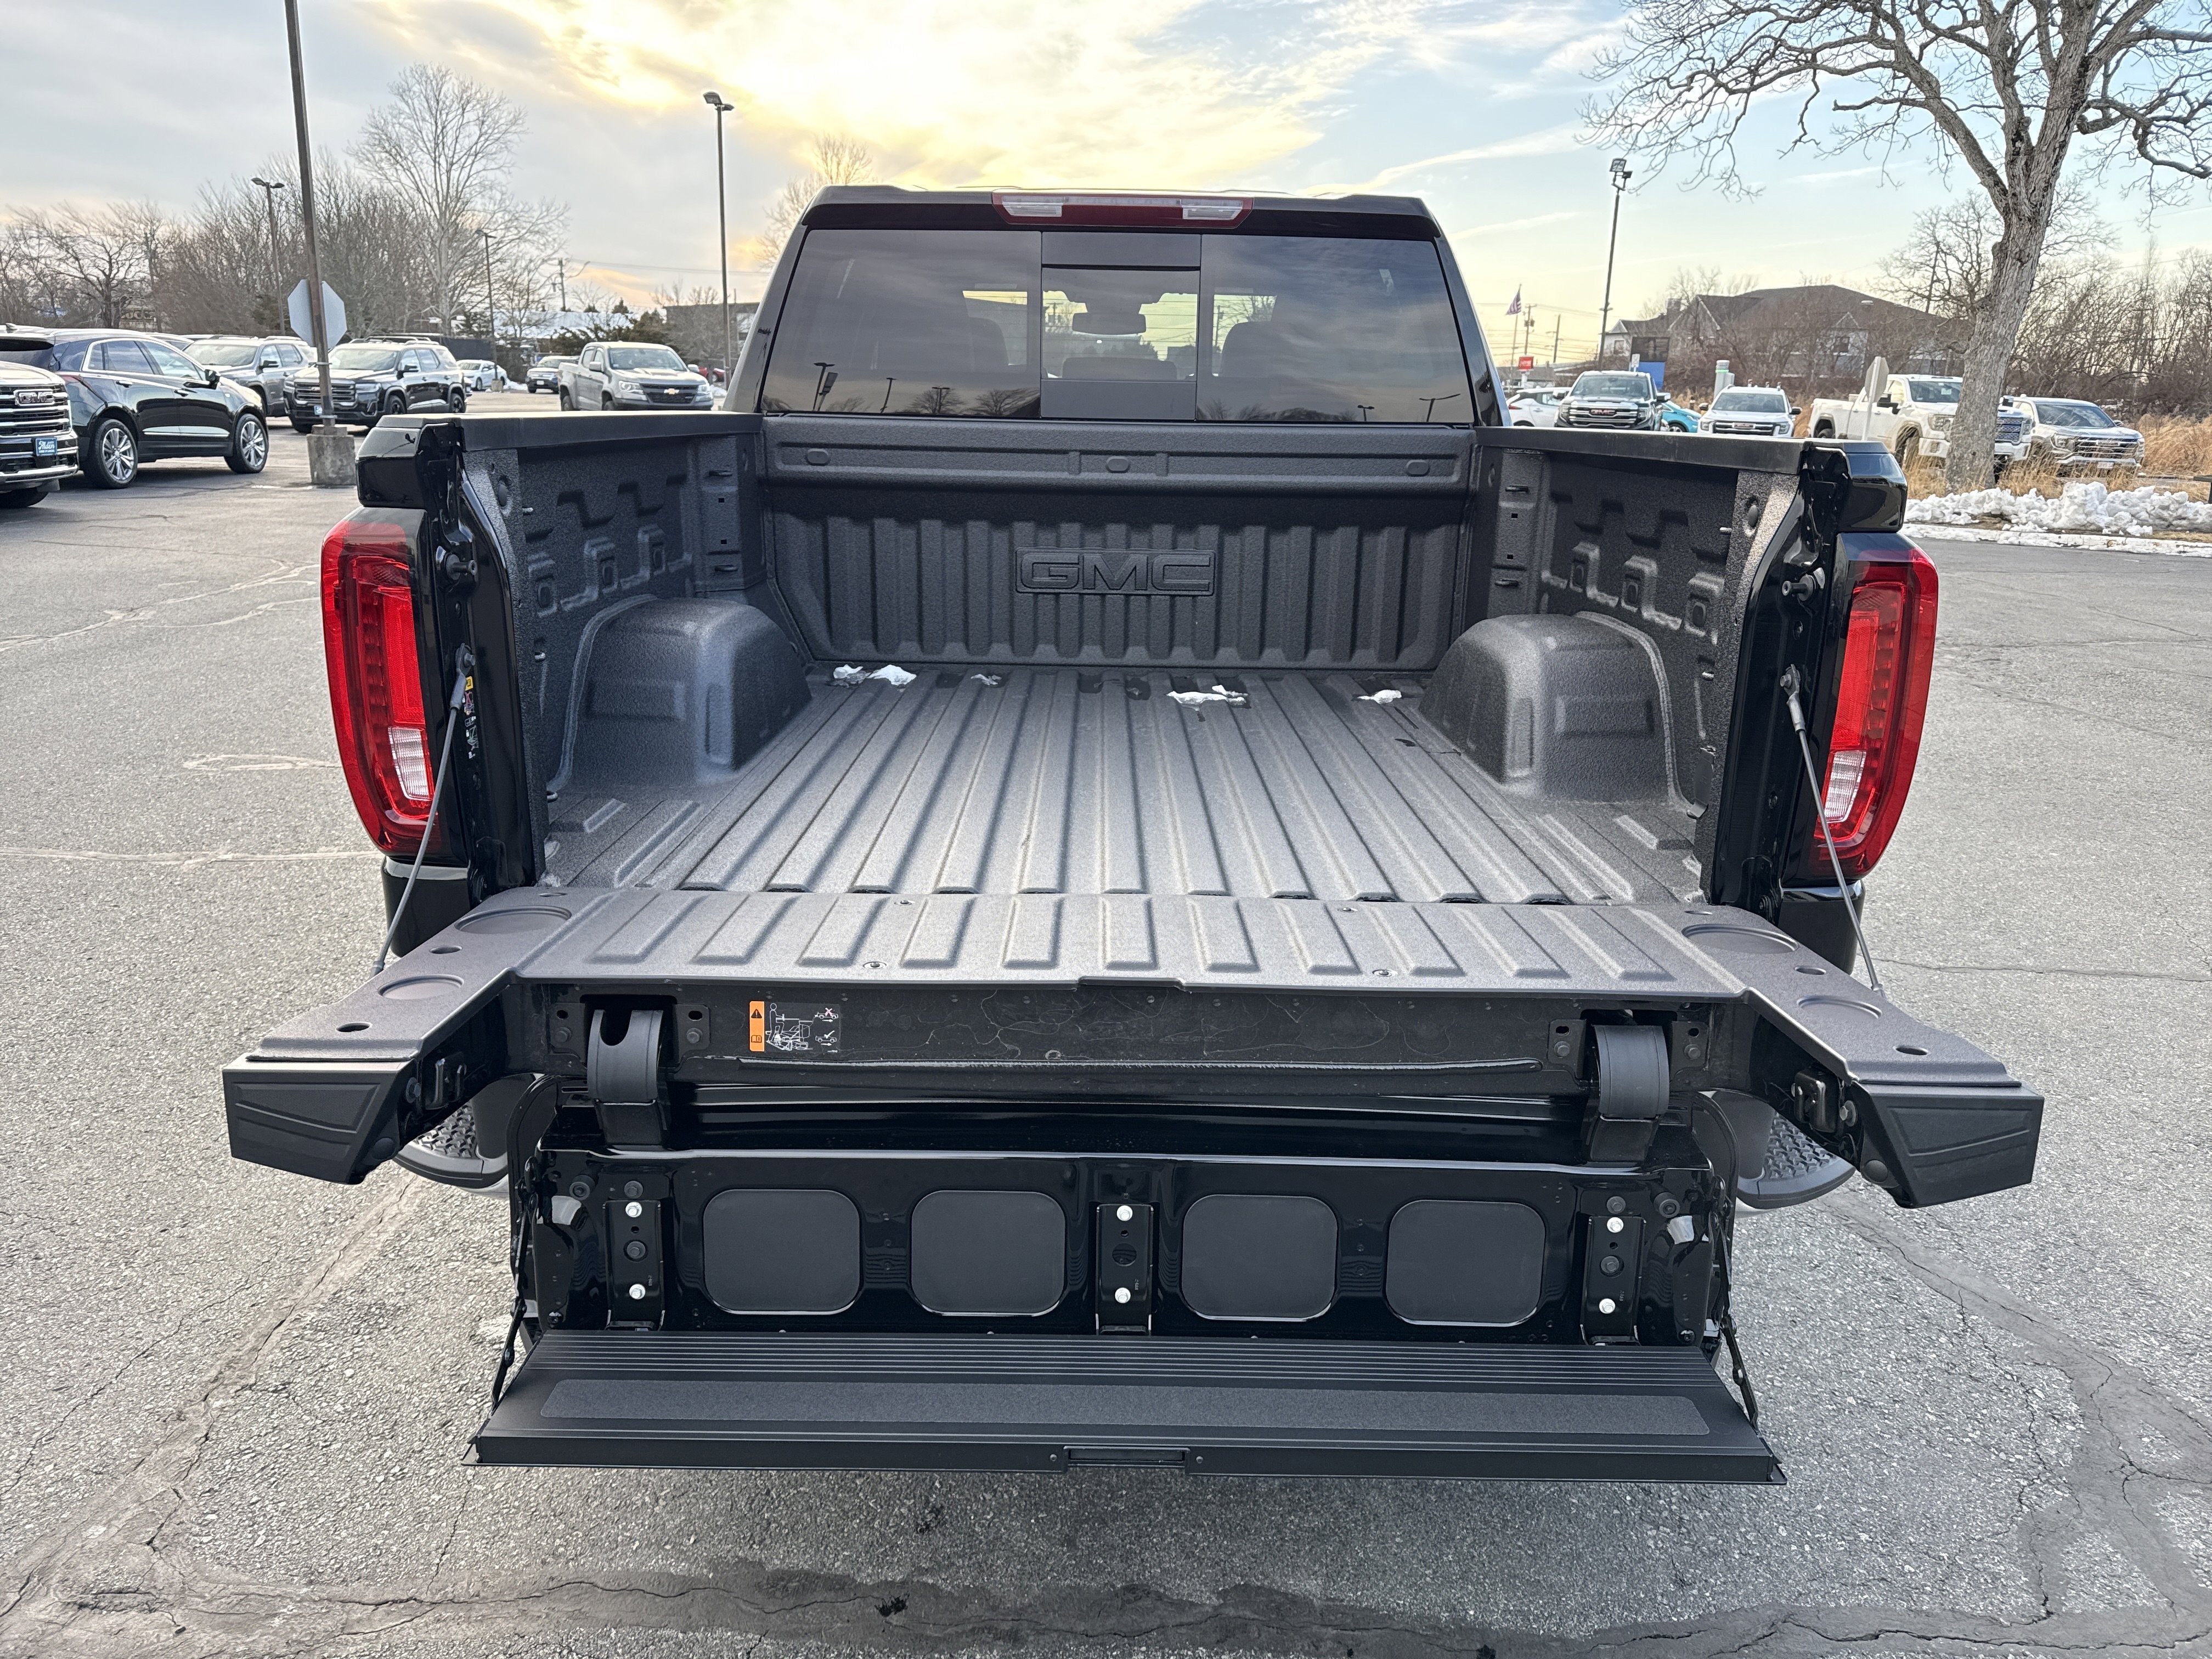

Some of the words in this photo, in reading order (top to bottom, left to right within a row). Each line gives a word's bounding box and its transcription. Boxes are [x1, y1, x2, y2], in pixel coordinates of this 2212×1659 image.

[18, 392, 54, 404] GMC
[38, 441, 55, 450] Alden
[1020, 552, 1211, 592] GMC
